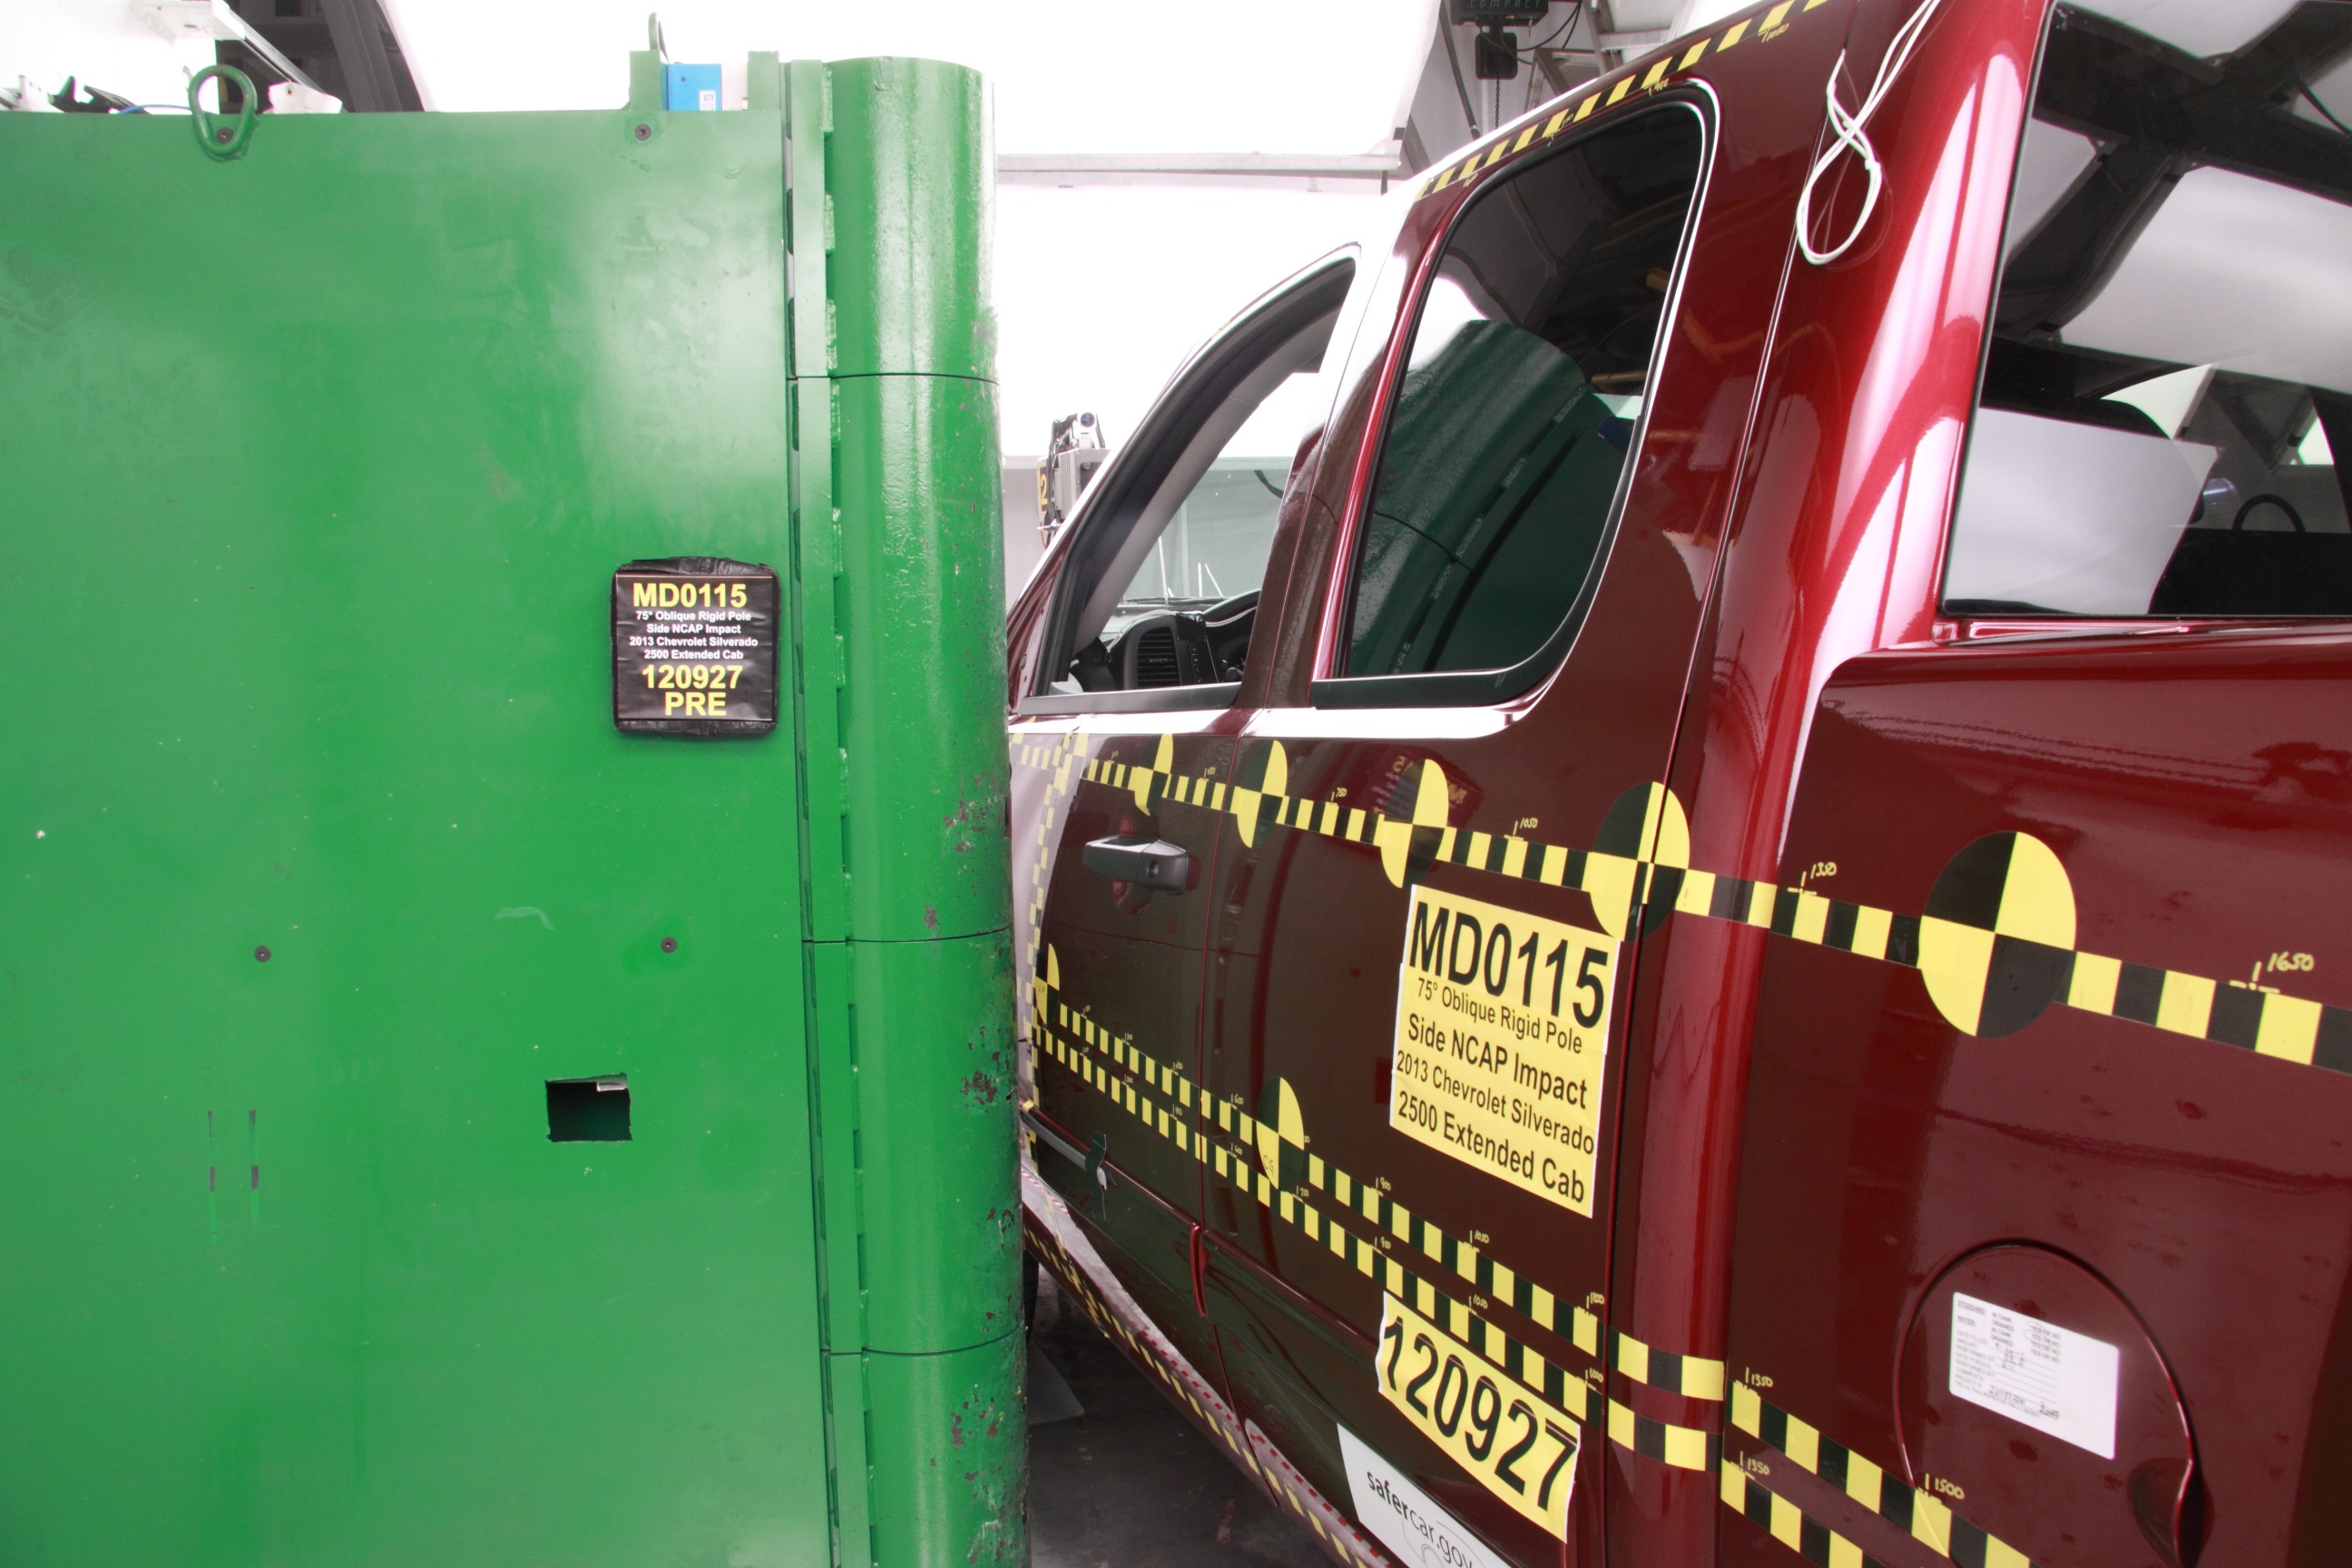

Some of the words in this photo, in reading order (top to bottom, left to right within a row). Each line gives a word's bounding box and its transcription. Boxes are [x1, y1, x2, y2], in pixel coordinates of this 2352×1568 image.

[632, 583, 747, 608] MD0115
[646, 623, 670, 633] Side
[671, 623, 703, 633] NCAP
[705, 623, 741, 635] Impact
[655, 611, 696, 622] Oblique
[698, 611, 725, 623] Rigid
[728, 612, 751, 621] Pole
[629, 637, 654, 646] 2013
[656, 637, 707, 646] Chevrolet
[709, 637, 759, 647] Silverado
[643, 650, 669, 659] 2500
[671, 650, 720, 660] Extended
[722, 650, 744, 660] Cab
[642, 664, 743, 690] 120927
[664, 692, 727, 716] PRE
[1409, 901, 1609, 1028] MD0115
[2267, 951, 2314, 972] 1650
[1442, 986, 1495, 1024] Oblique
[1501, 1005, 1540, 1041] Rigid
[1546, 1021, 1582, 1054] Pole
[1408, 1013, 1446, 1053] Side
[1452, 1028, 1508, 1075] NCAP
[1514, 1053, 1587, 1110] Impact
[1396, 1049, 1428, 1083] 2013
[1433, 1065, 1506, 1119] Chevrolet
[1511, 1098, 1594, 1155] Silverado
[1398, 1090, 1437, 1132] 2500
[1444, 1112, 1534, 1181] Extended
[1543, 1157, 1584, 1204] Cab
[1750, 1374, 1774, 1387] 1350
[1384, 1315, 1578, 1513] 120927
[1748, 1458, 1770, 1475] 1350
[1935, 1477, 1965, 1500] 1500
